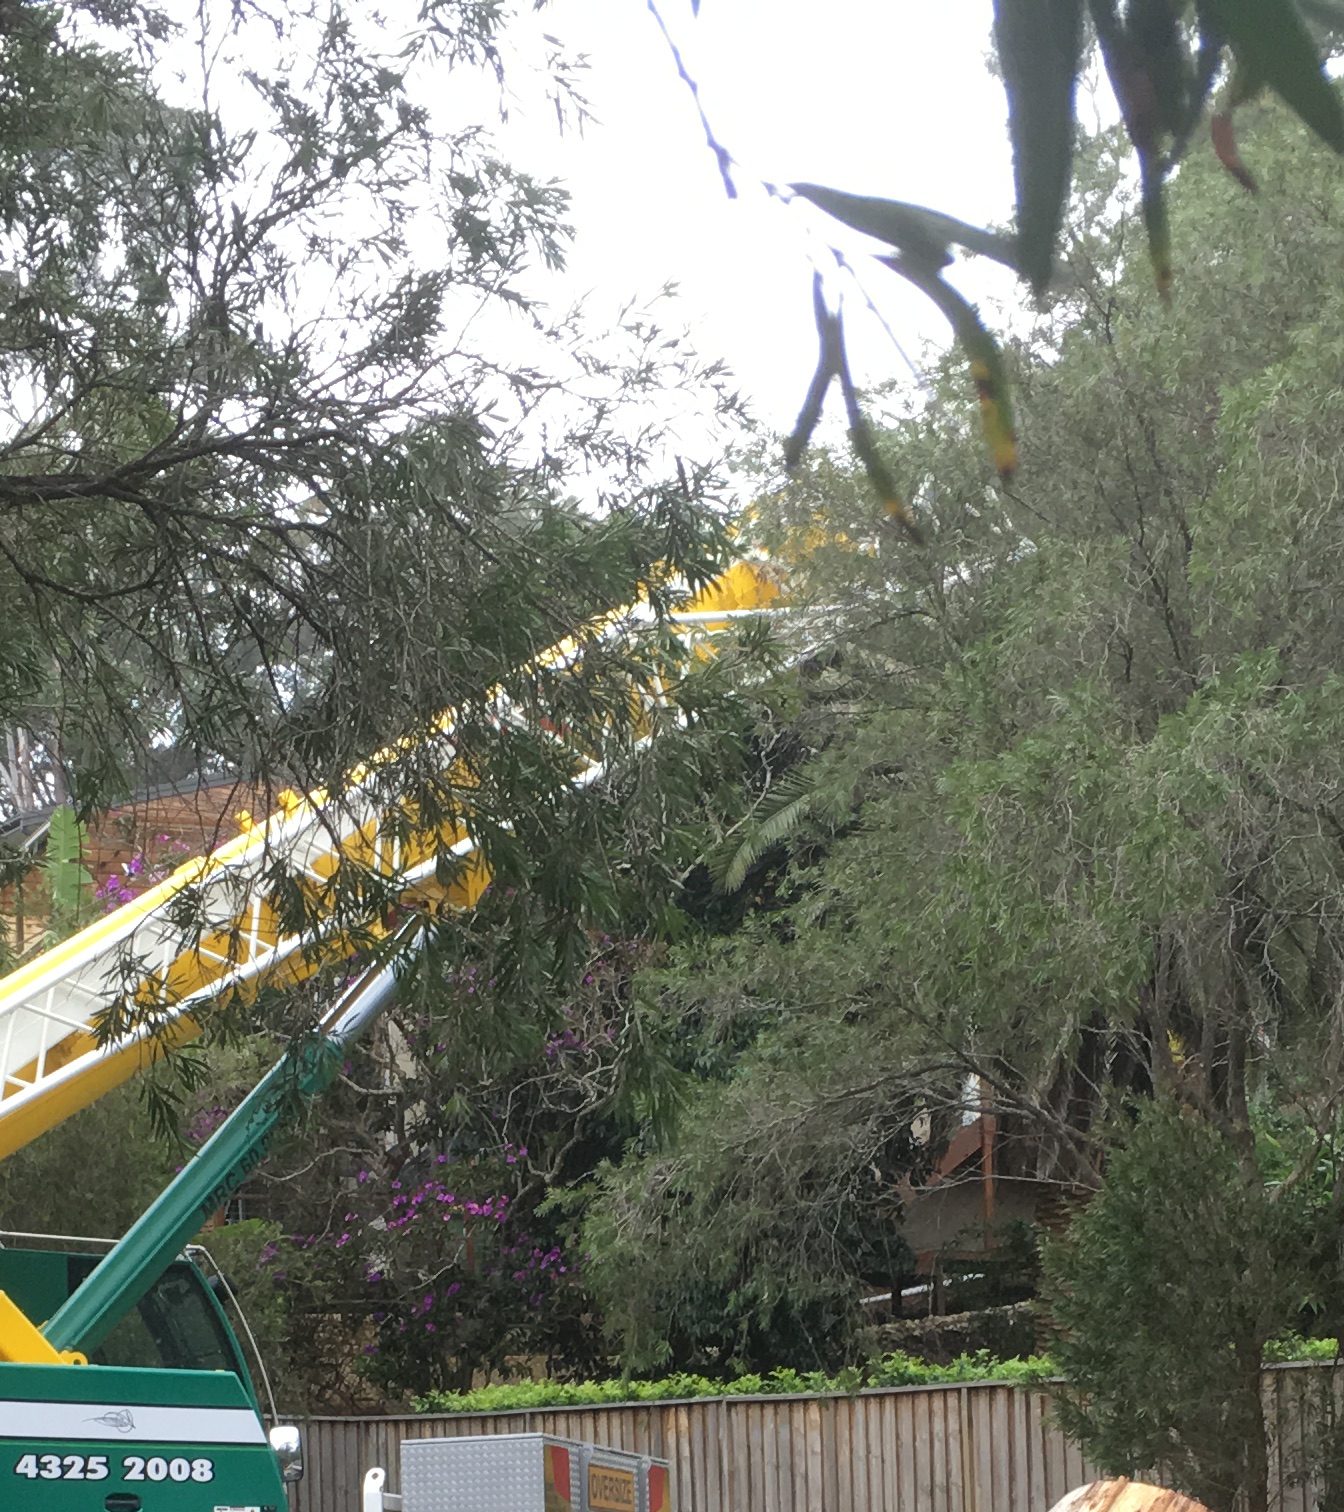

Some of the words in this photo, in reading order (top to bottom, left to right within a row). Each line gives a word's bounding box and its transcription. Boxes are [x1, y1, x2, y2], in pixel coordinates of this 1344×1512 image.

[15, 1454, 109, 1480] 4325
[123, 1456, 213, 1482] 2008
[590, 1472, 633, 1505] OVERSIZE
